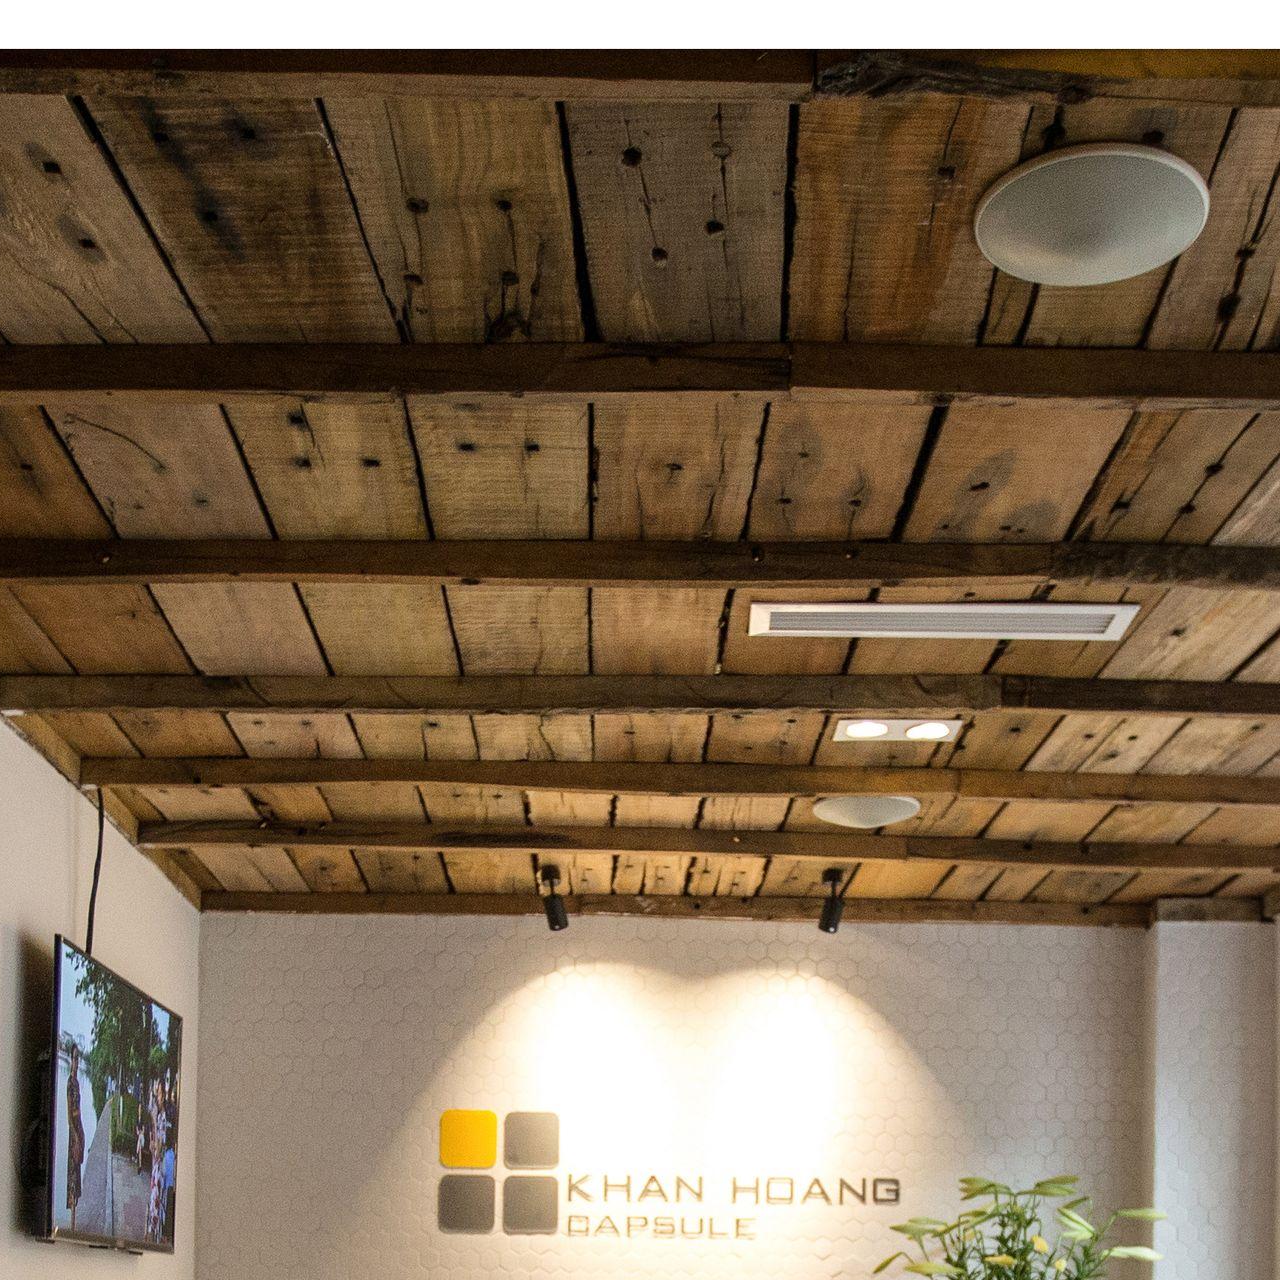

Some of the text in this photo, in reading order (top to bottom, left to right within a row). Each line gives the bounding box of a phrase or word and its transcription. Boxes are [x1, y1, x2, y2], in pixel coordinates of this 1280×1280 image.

[567, 1174, 901, 1206] KHAN HOANG
[567, 1214, 757, 1240] CAPSULE
